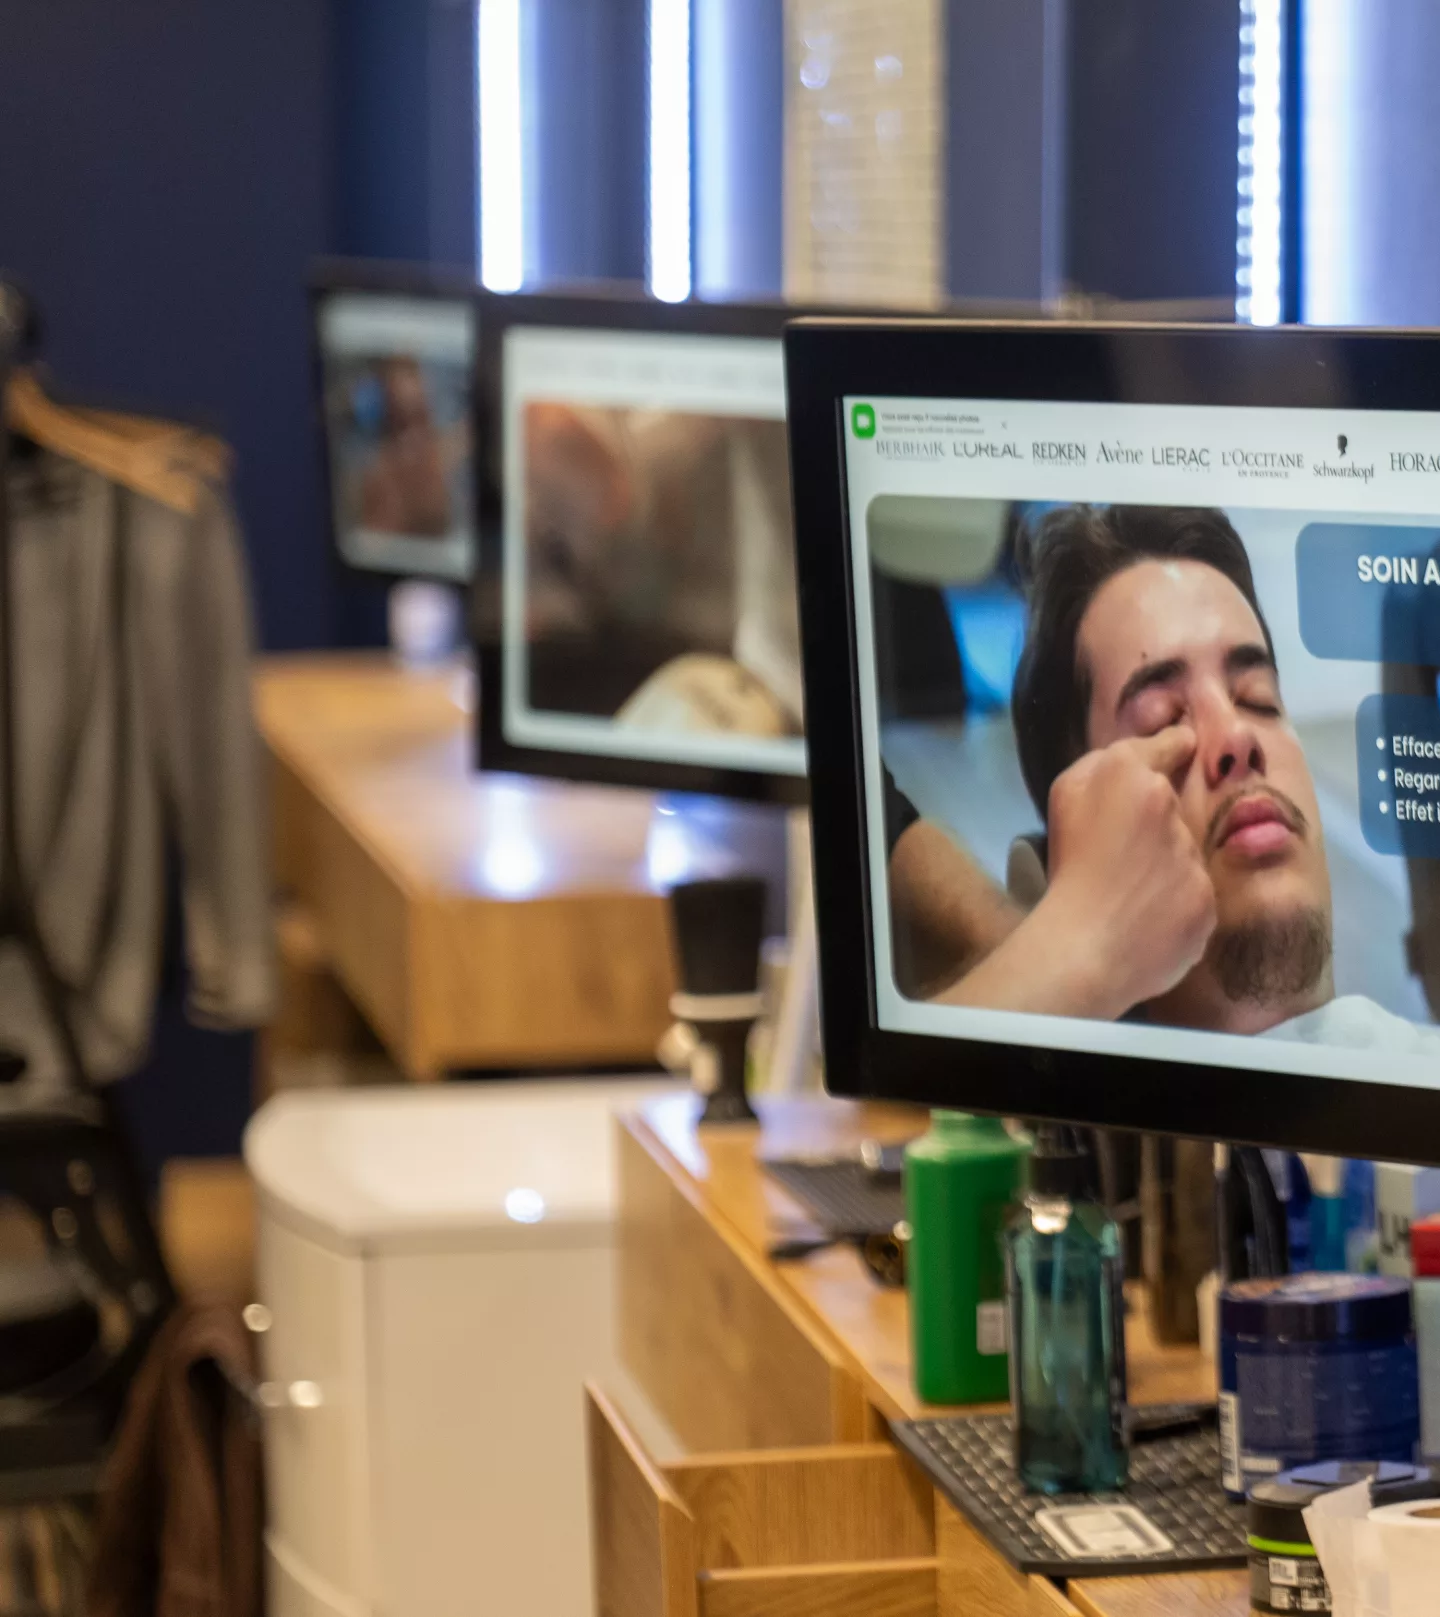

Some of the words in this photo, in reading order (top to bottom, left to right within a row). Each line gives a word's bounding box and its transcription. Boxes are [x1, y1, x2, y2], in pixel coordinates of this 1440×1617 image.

[1032, 442, 1086, 461] REDKEN
[1096, 440, 1144, 465] Avène
[1152, 447, 1210, 467] LIERAC
[1221, 448, 1304, 469] L'OCCITANE
[1312, 460, 1375, 484] Schwarzkopf
[1357, 555, 1418, 584] SOIN
[1396, 800, 1433, 821] Effet
